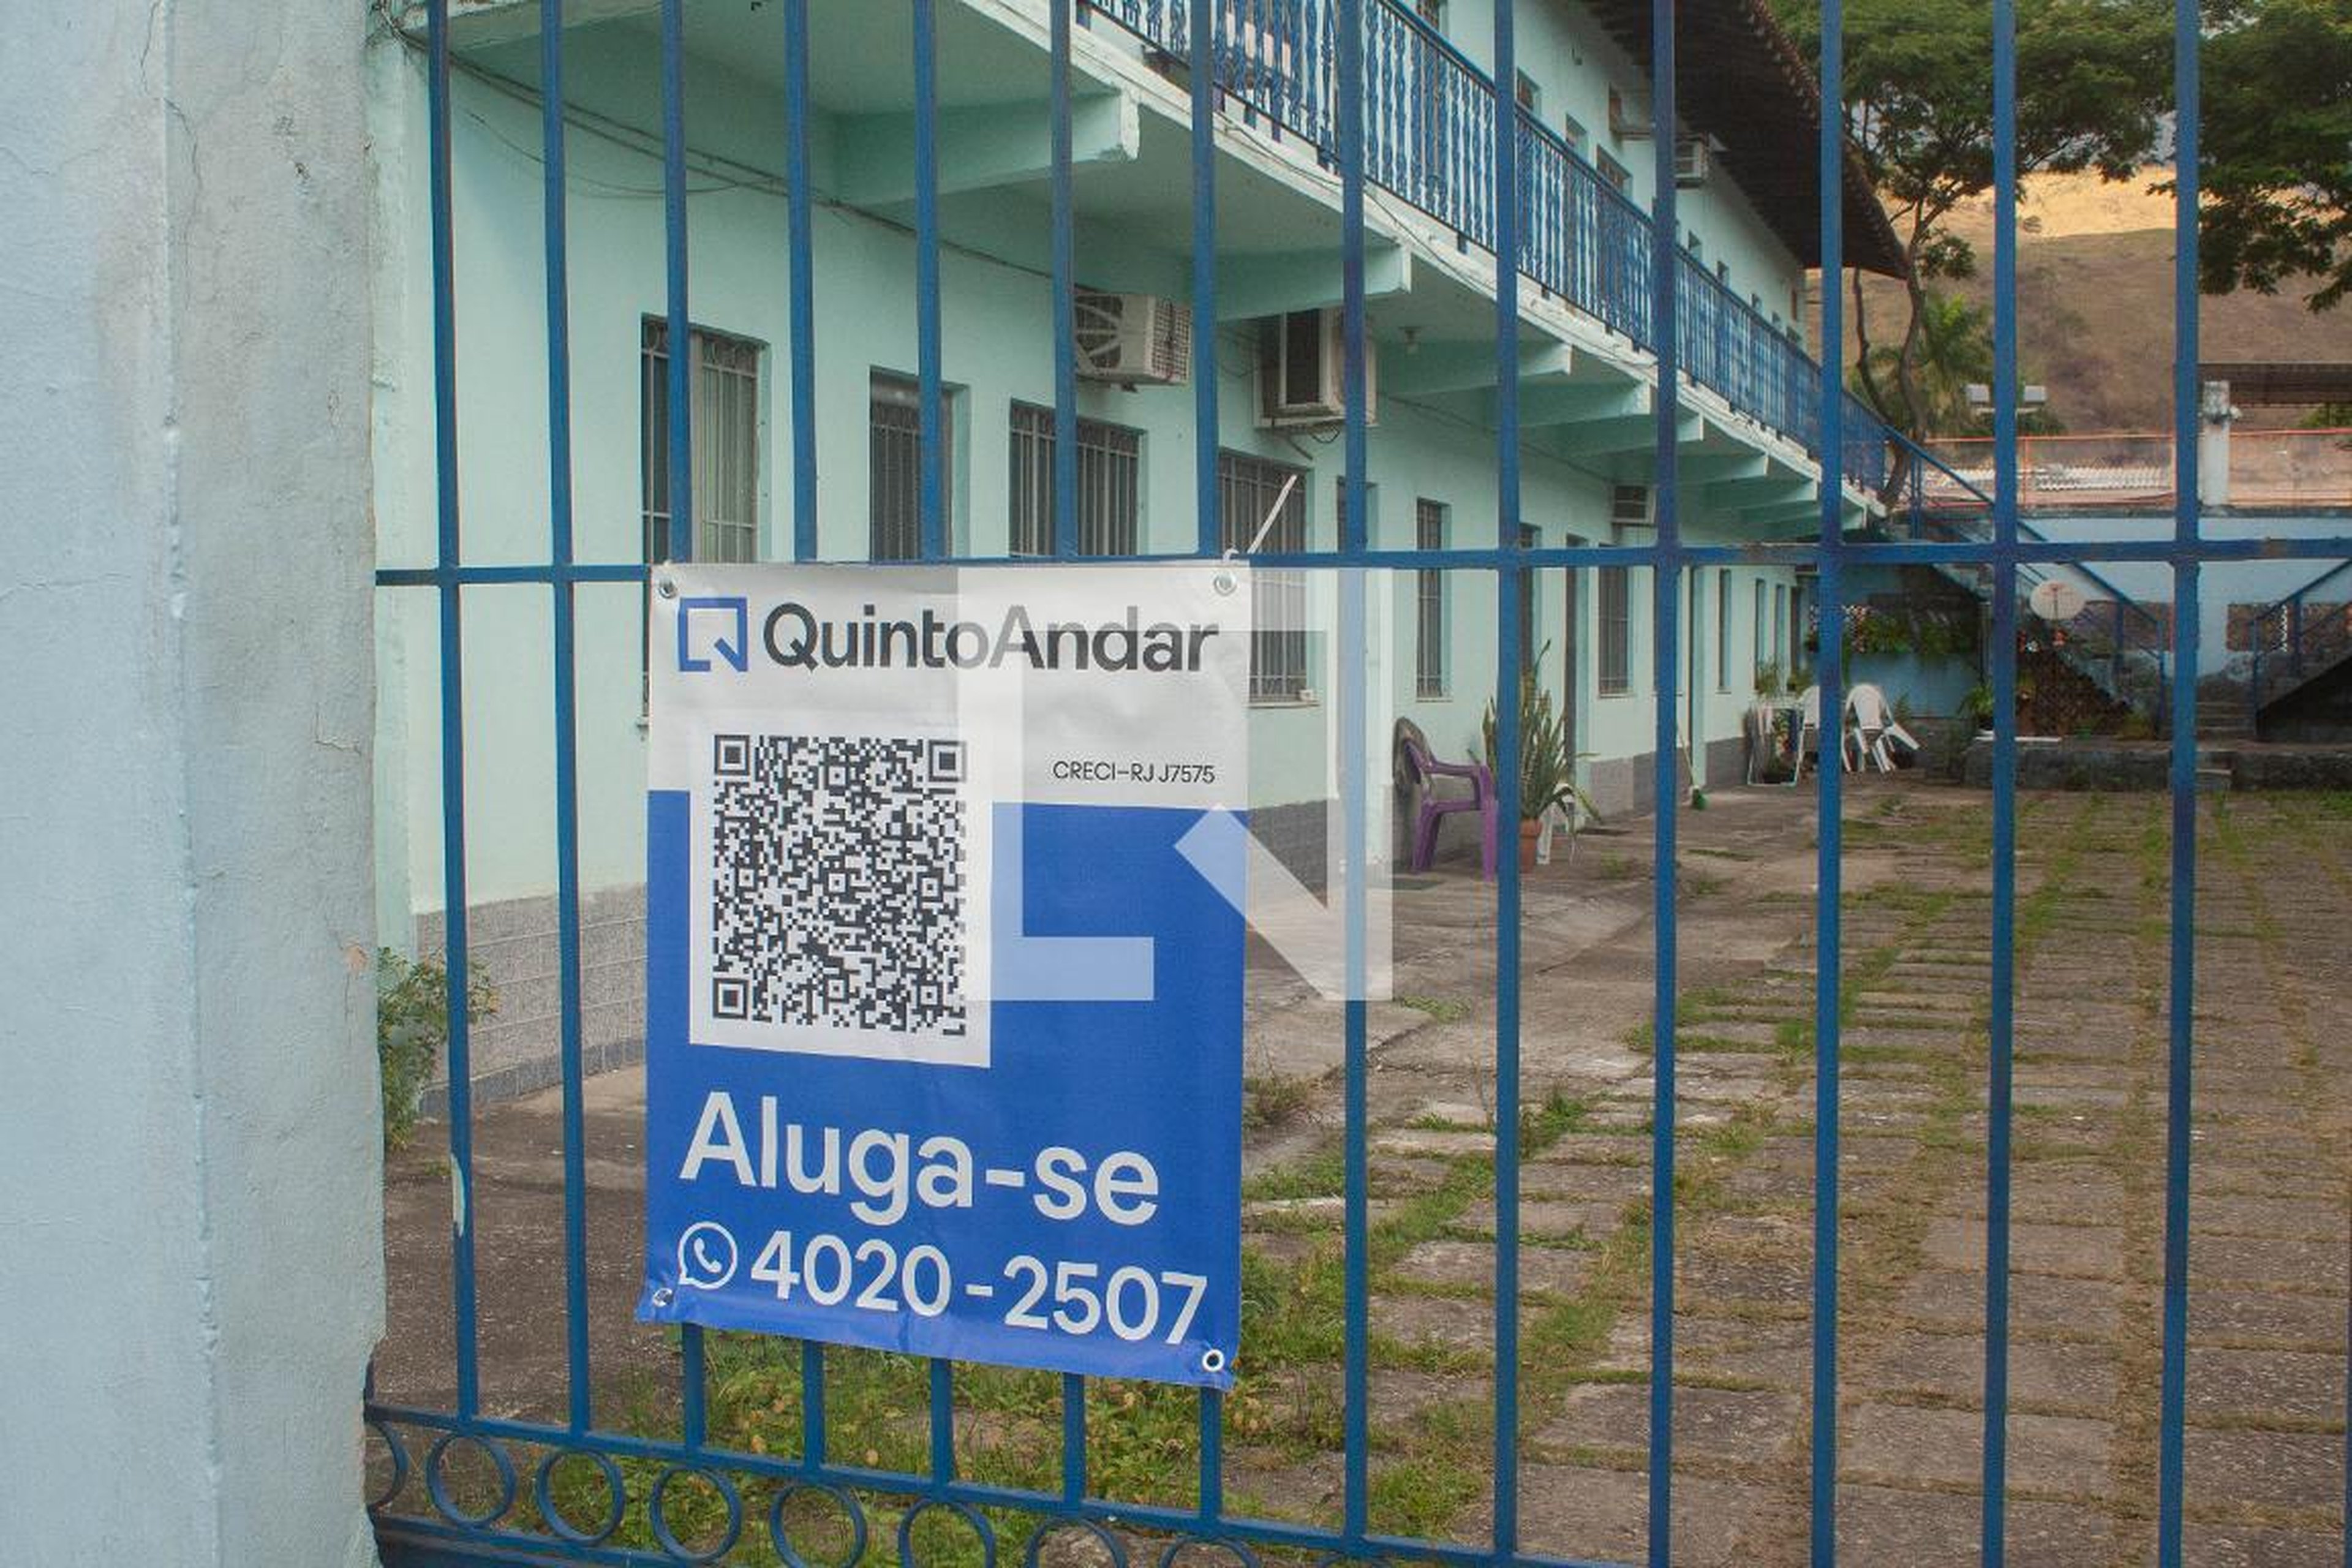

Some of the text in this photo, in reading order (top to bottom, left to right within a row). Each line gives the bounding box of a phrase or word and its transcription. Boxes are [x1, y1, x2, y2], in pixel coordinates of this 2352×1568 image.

[761, 601, 1220, 674] QuintoAndar
[1052, 761, 1216, 784] CRECI-RJ J7575
[679, 1091, 1159, 1226] Aluga-se
[750, 1230, 1208, 1346] 4020-2507
